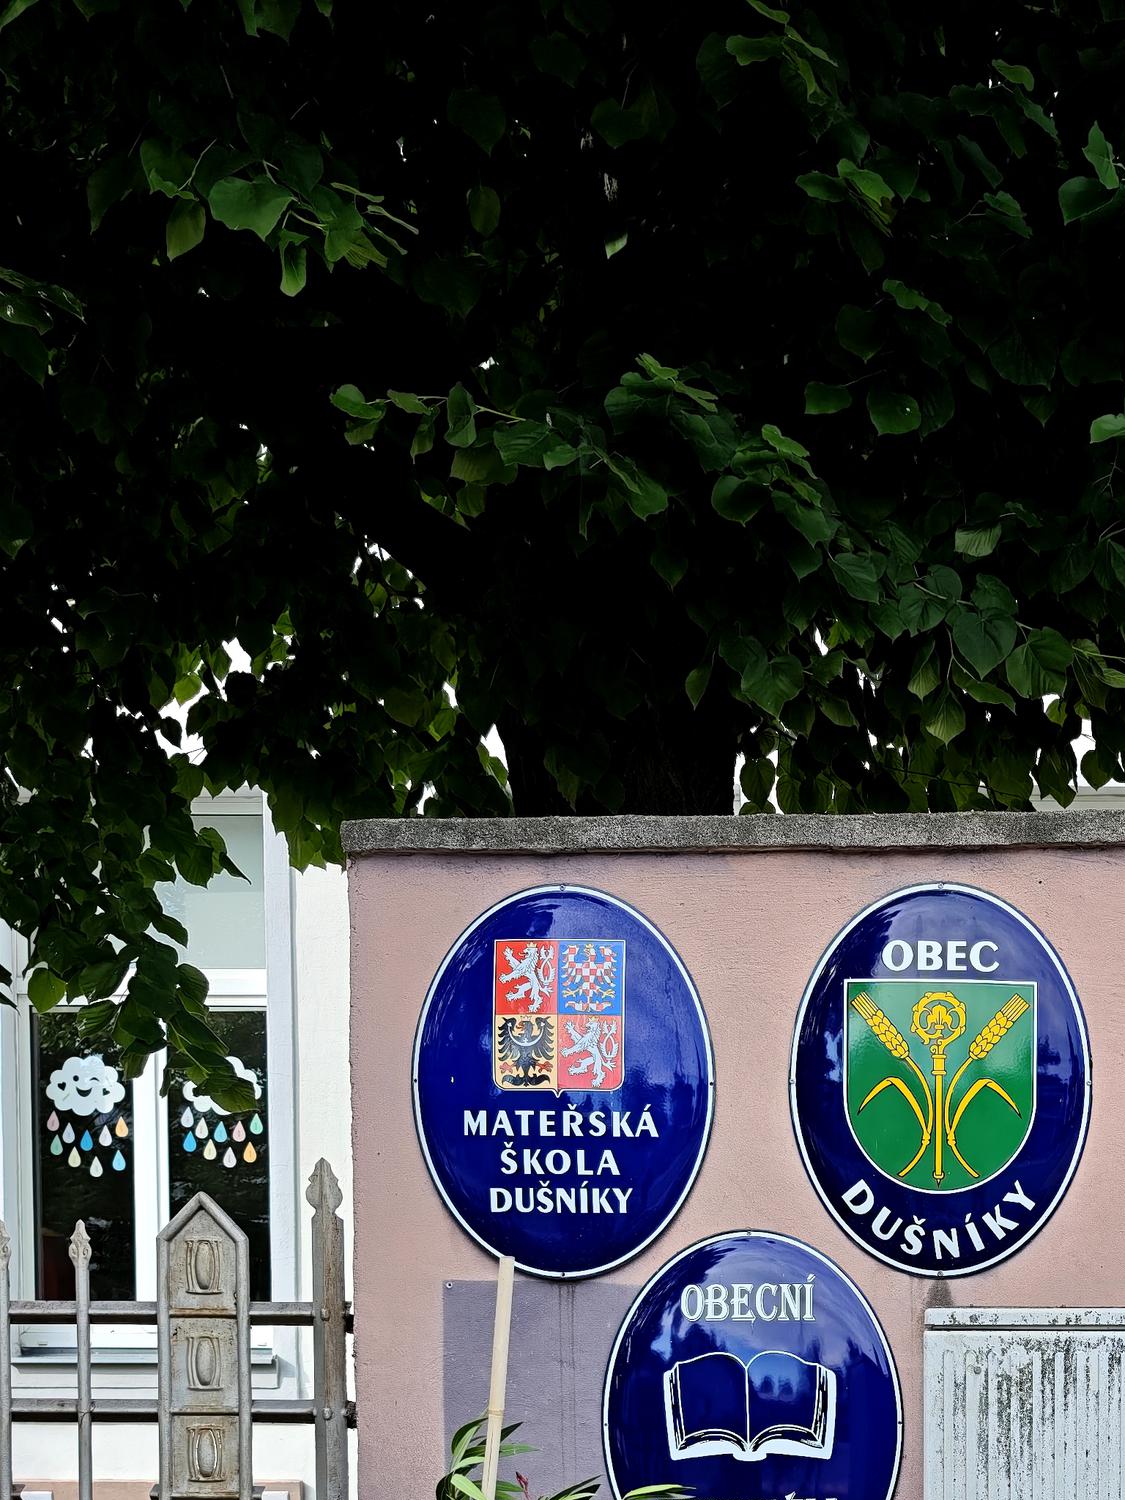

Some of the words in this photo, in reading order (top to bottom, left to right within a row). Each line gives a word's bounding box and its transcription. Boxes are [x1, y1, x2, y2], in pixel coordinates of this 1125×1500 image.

[882, 940, 1001, 973] OBEC
[462, 1104, 660, 1139] MATEŘSKÁ
[500, 1145, 621, 1176] ŠKOLA
[489, 1182, 634, 1214] DUŠNÍKY
[841, 1178, 1036, 1259] DUŠNÍKY
[680, 1275, 816, 1322] OBECNÍ
